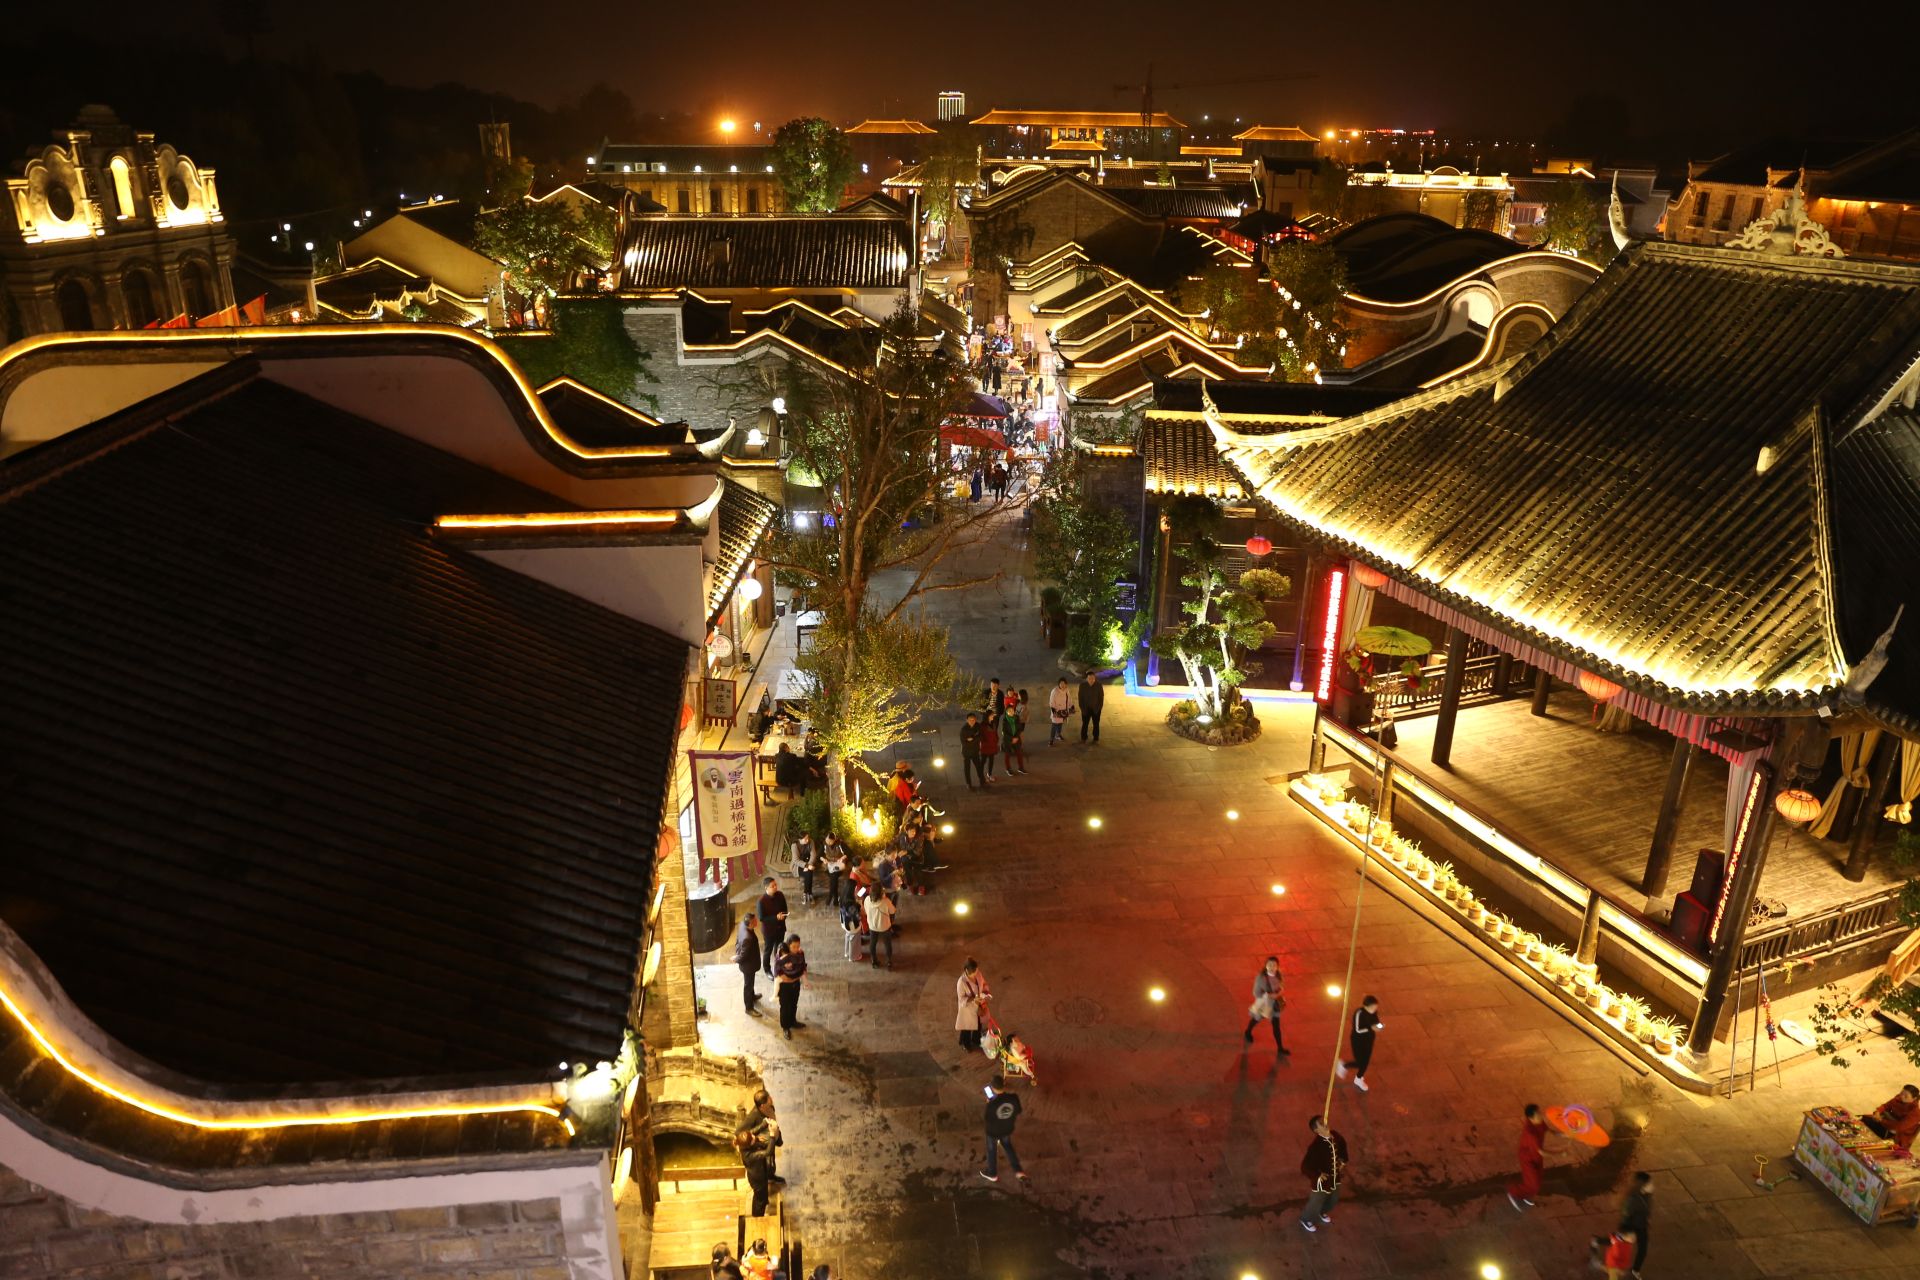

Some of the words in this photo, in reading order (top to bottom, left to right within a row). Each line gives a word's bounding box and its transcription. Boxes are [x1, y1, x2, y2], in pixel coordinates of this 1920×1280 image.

[728, 769, 748, 847] 雲南過橋米線
